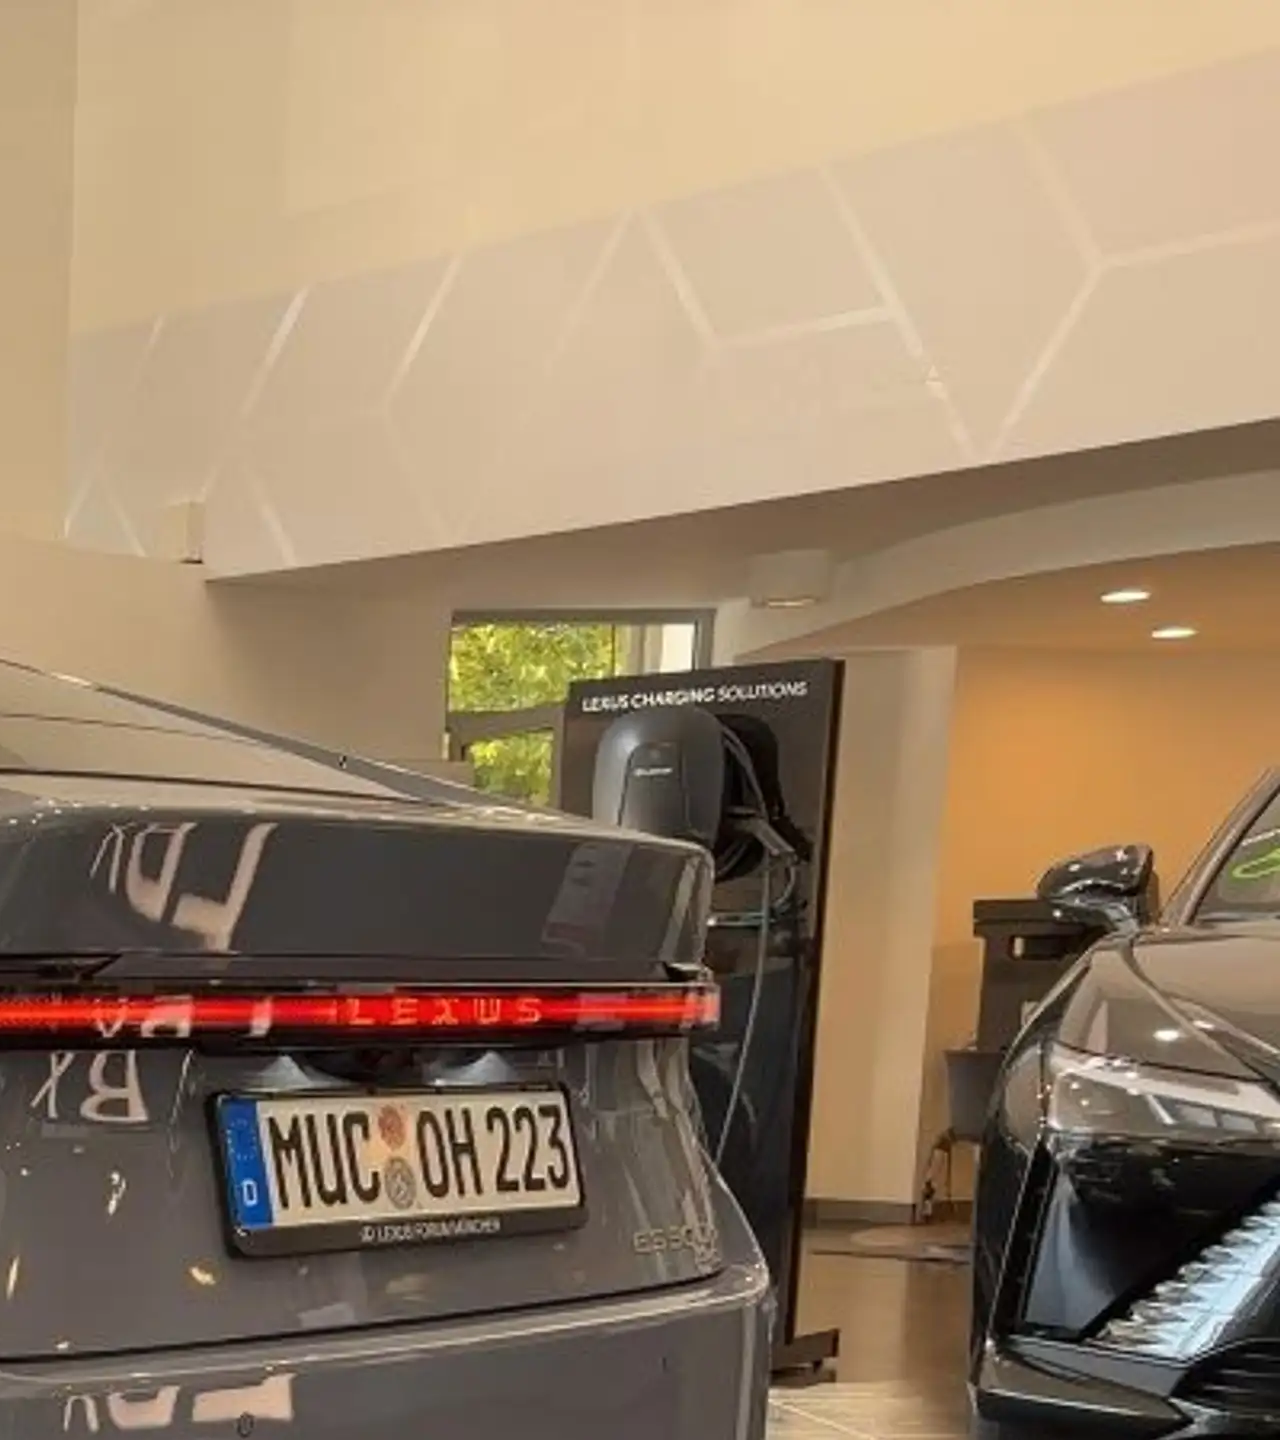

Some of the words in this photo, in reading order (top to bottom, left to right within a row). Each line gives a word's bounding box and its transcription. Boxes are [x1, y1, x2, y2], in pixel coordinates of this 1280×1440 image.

[581, 694, 630, 712] LEXUS
[630, 687, 716, 709] CHARGING
[717, 681, 808, 702] SOLUTIONS
[348, 997, 542, 1026] LEXUS
[268, 1110, 382, 1209] MUC
[416, 1106, 485, 1198] OH
[486, 1103, 572, 1193] 223
[241, 1178, 259, 1207] D
